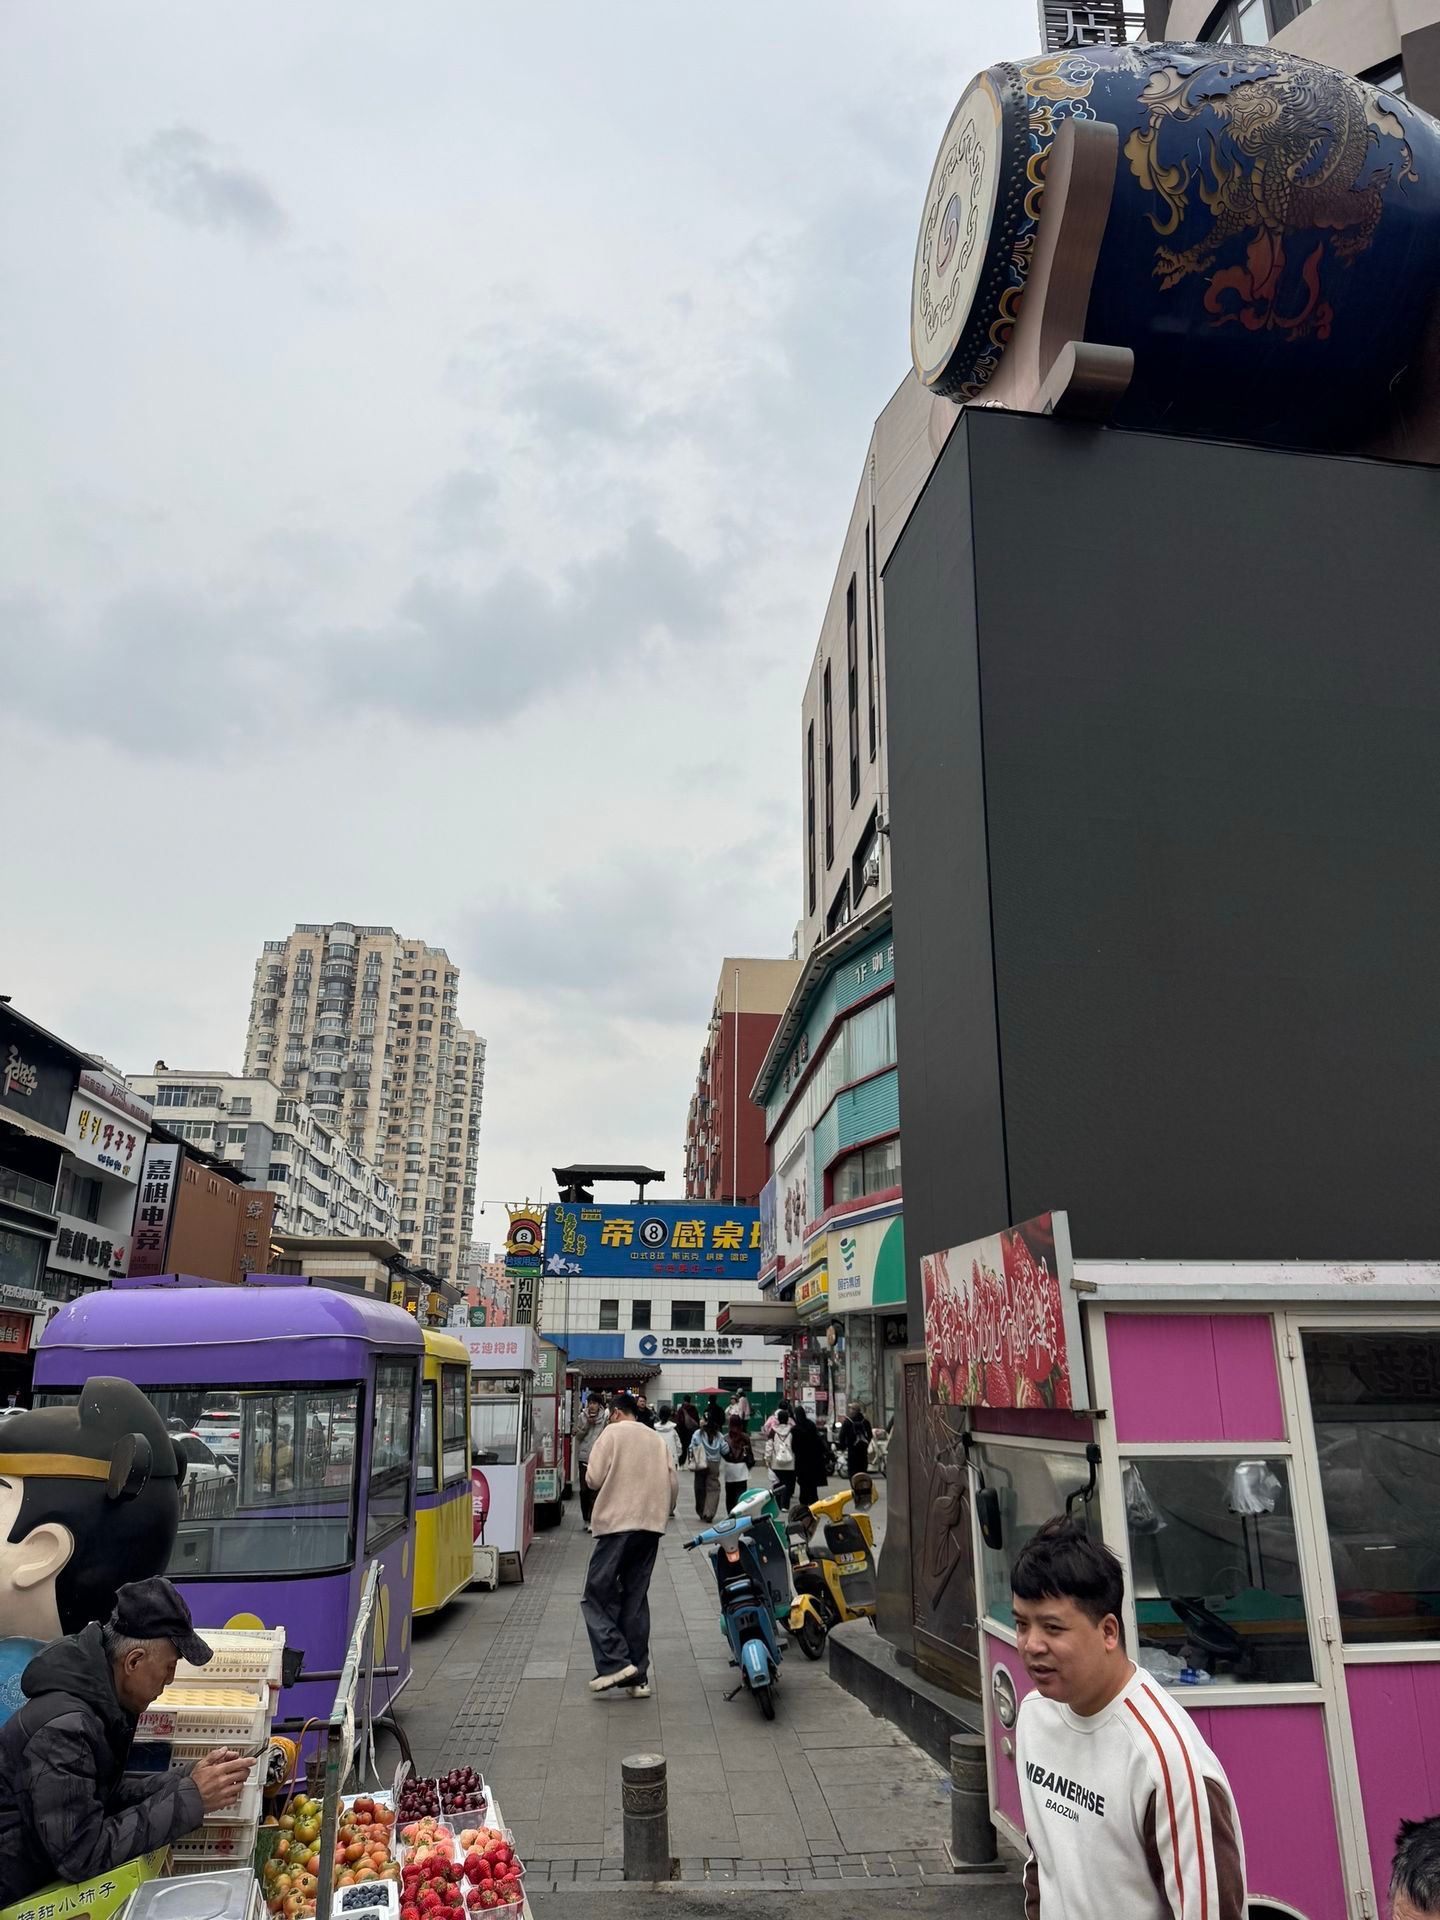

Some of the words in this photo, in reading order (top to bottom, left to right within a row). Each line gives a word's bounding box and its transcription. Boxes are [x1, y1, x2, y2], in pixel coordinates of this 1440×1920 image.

[135, 1159, 173, 1250] 嘉棋电竞
[837, 1275, 861, 1292] 国药集团
[662, 1337, 743, 1348] 中国建设银行
[662, 1347, 679, 1355] China
[680, 1347, 717, 1355] Construction
[17, 1881, 116, 1920] 特甜小柿子
